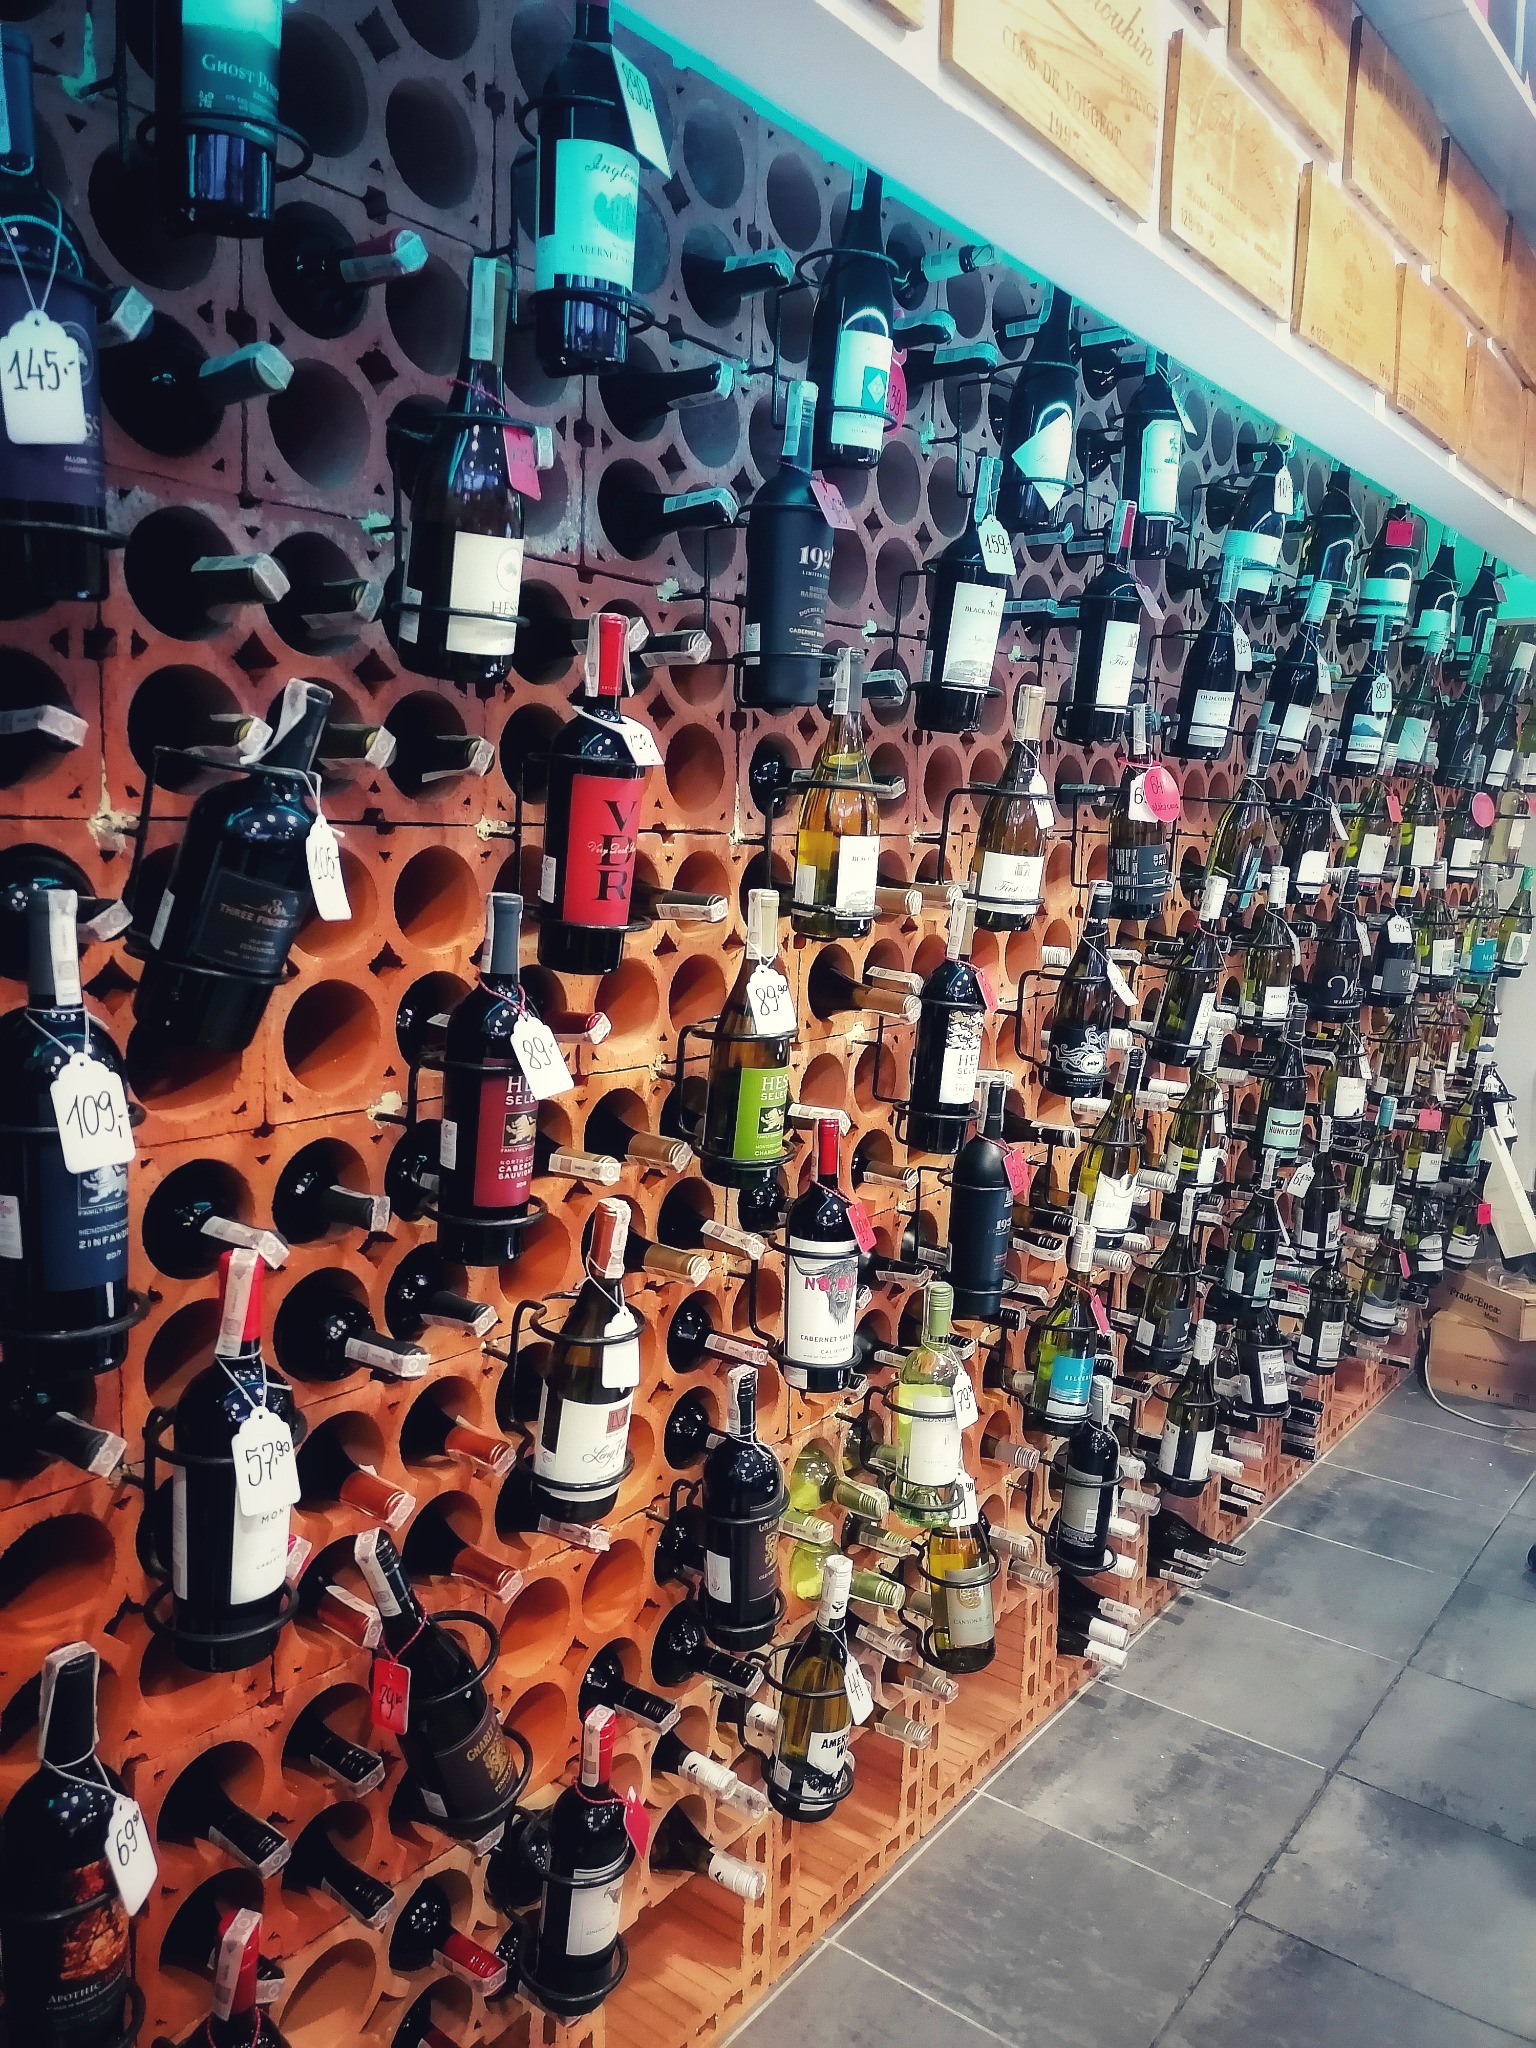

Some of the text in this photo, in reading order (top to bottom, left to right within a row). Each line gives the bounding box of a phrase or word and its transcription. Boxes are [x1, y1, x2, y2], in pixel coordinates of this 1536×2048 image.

[1090, 0, 1154, 67] ouhin
[202, 53, 255, 84] GHOST
[1002, 25, 1122, 148] CLOS DE VOUGEOT
[505, 1094, 536, 1107] SELE
[800, 1333, 838, 1344] CABERNET
